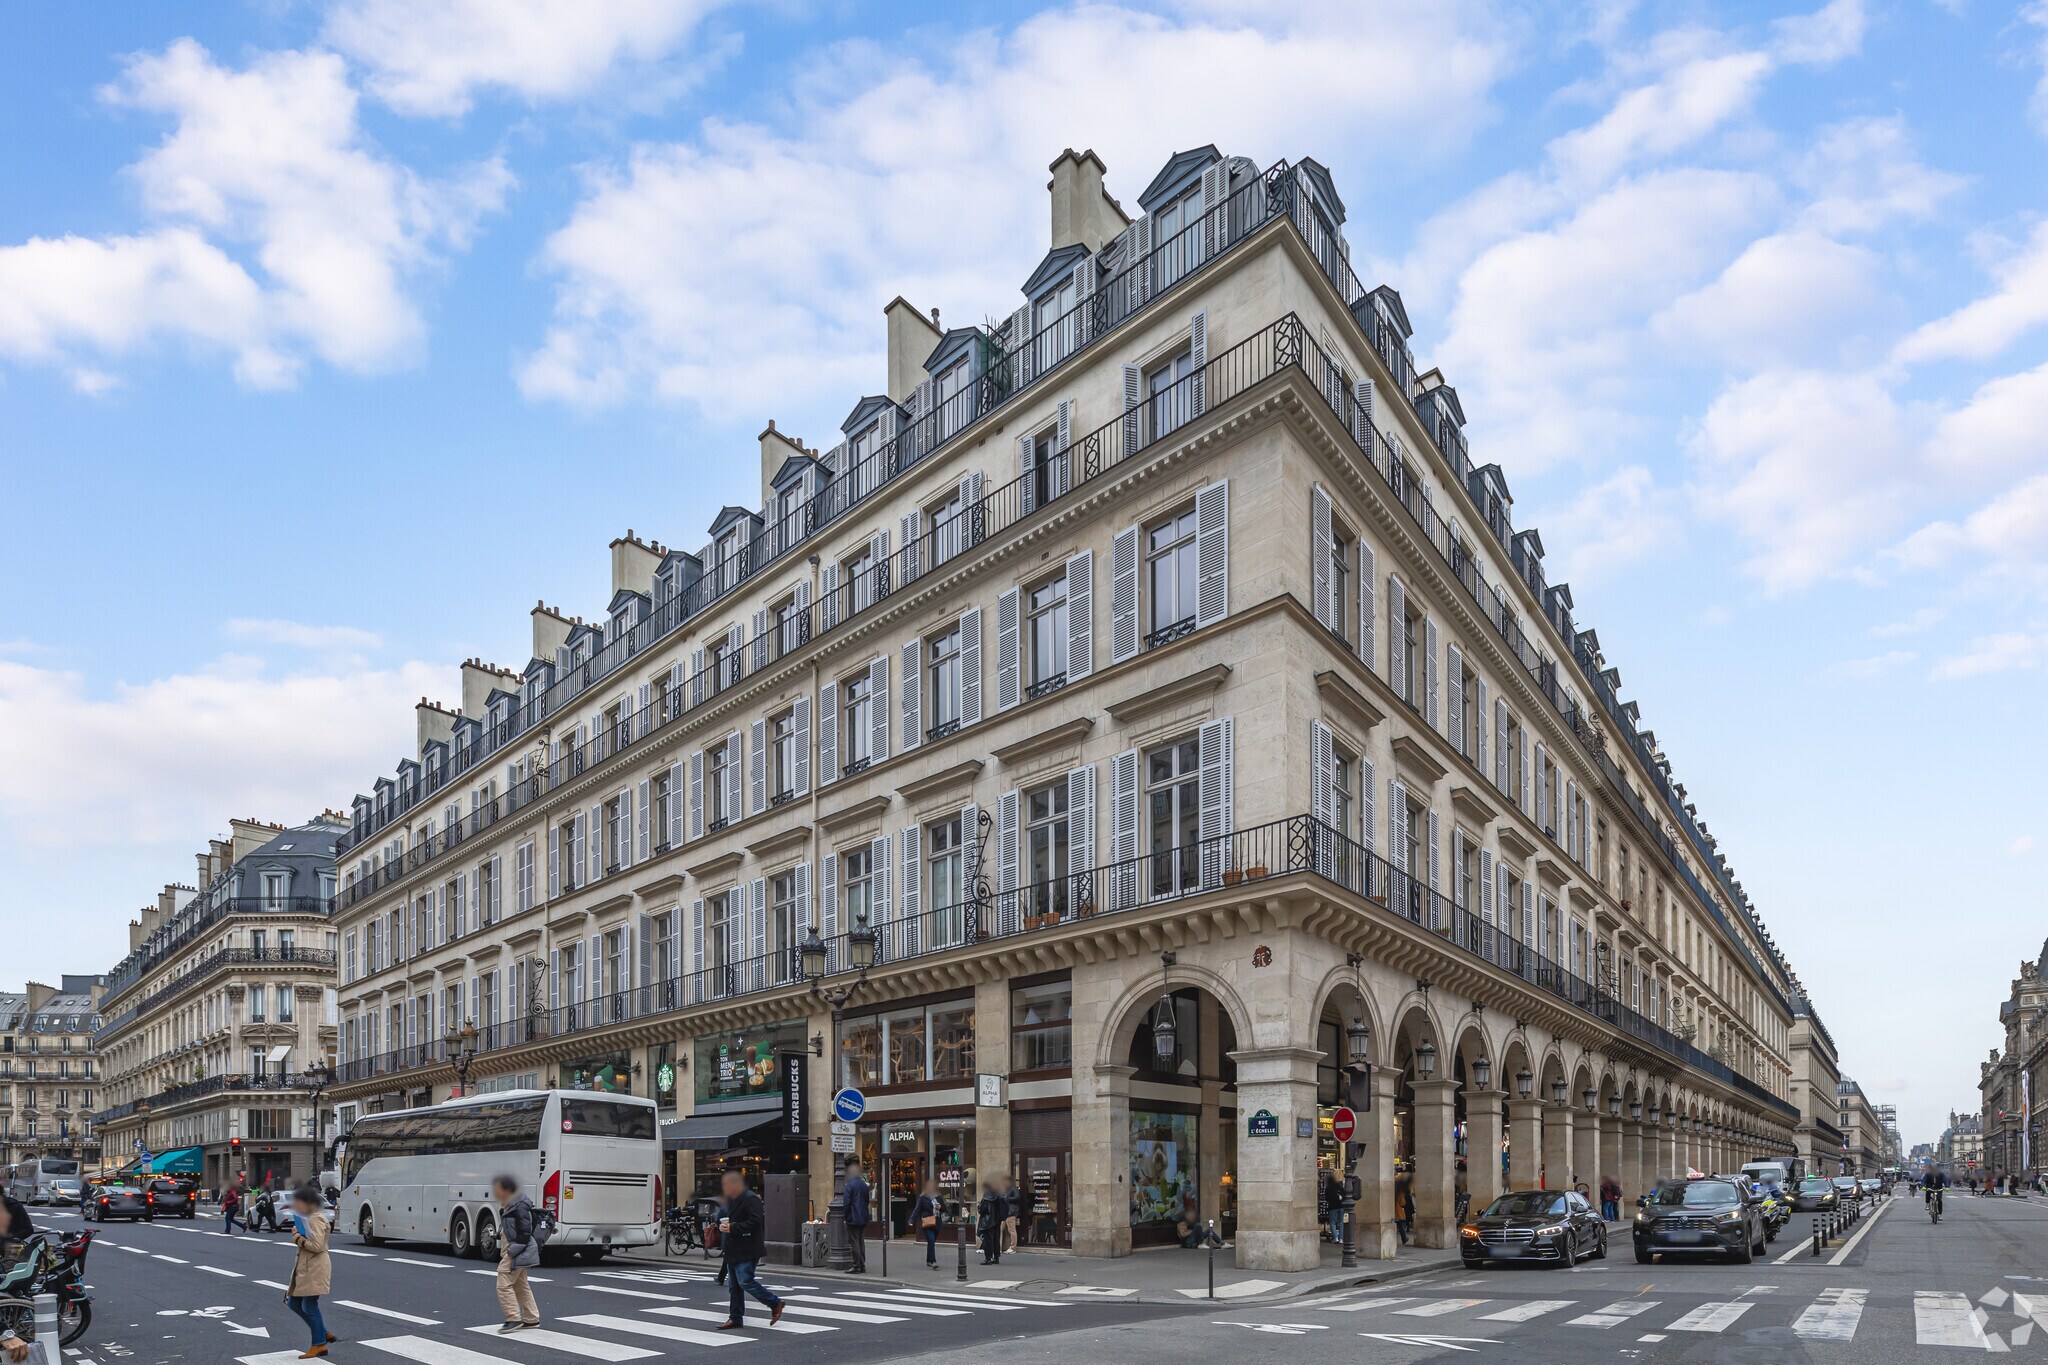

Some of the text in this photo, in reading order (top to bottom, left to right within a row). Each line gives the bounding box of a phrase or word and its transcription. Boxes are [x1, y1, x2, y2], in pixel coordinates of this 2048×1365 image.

[720, 1061, 735, 1069] MENU
[720, 1069, 733, 1077] TRIO
[790, 1059, 800, 1133] STARBUCKS
[888, 1132, 915, 1141] ALPHA
